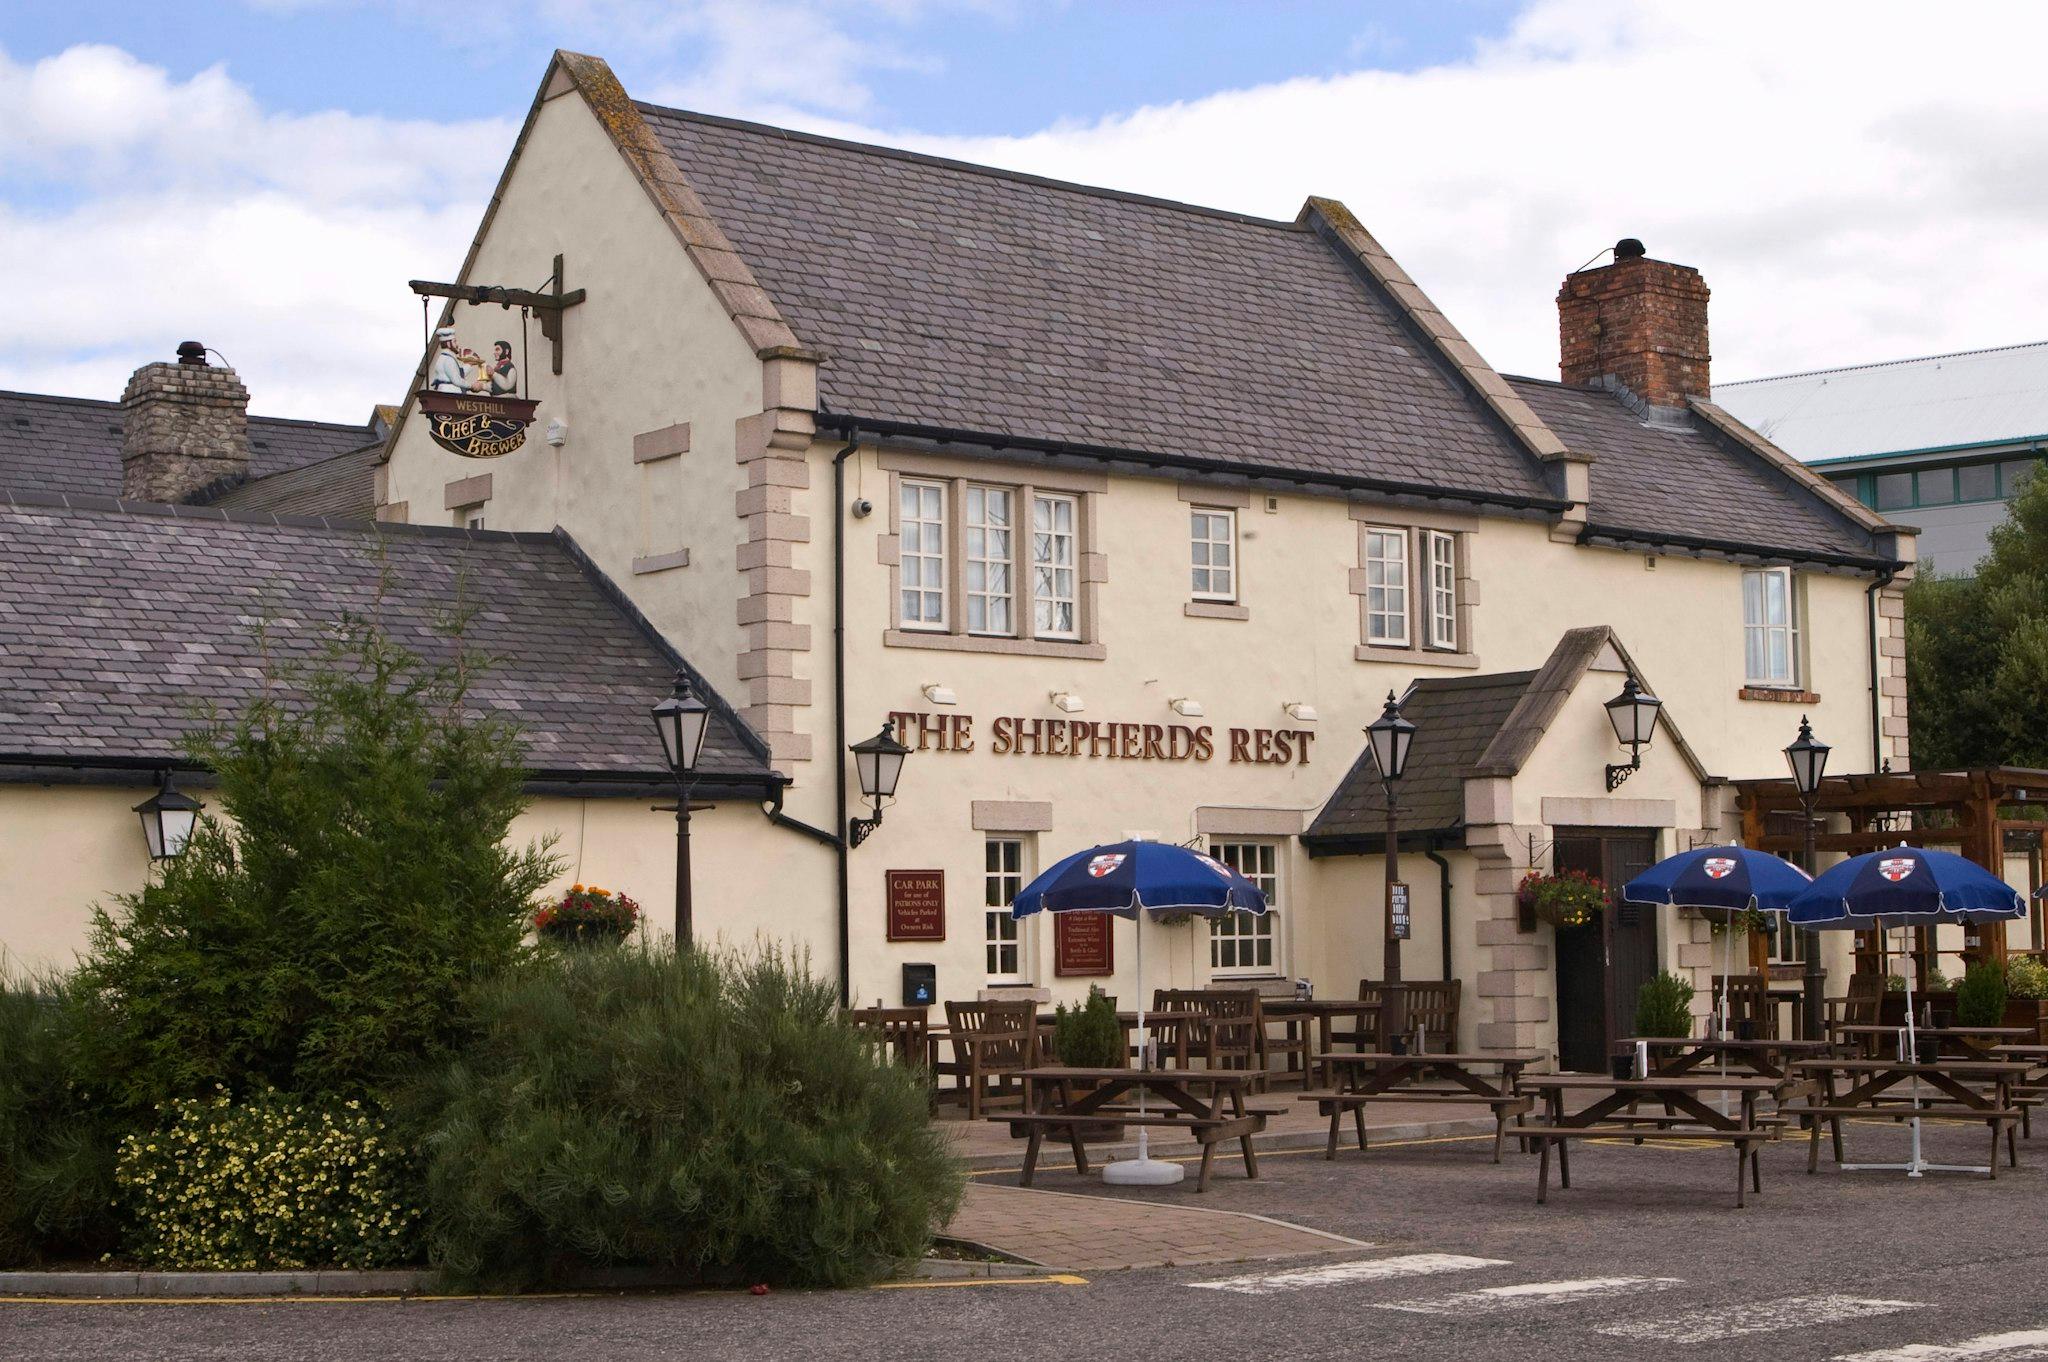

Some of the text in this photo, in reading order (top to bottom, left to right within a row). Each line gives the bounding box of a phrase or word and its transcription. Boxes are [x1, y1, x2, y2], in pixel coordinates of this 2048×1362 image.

[456, 400, 506, 414] WESTHILL
[439, 415, 491, 439] CHEF &
[467, 432, 525, 456] BREWER
[889, 711, 1315, 764] THE SHEPHERDS REST
[894, 880, 938, 889] CAR PARK
